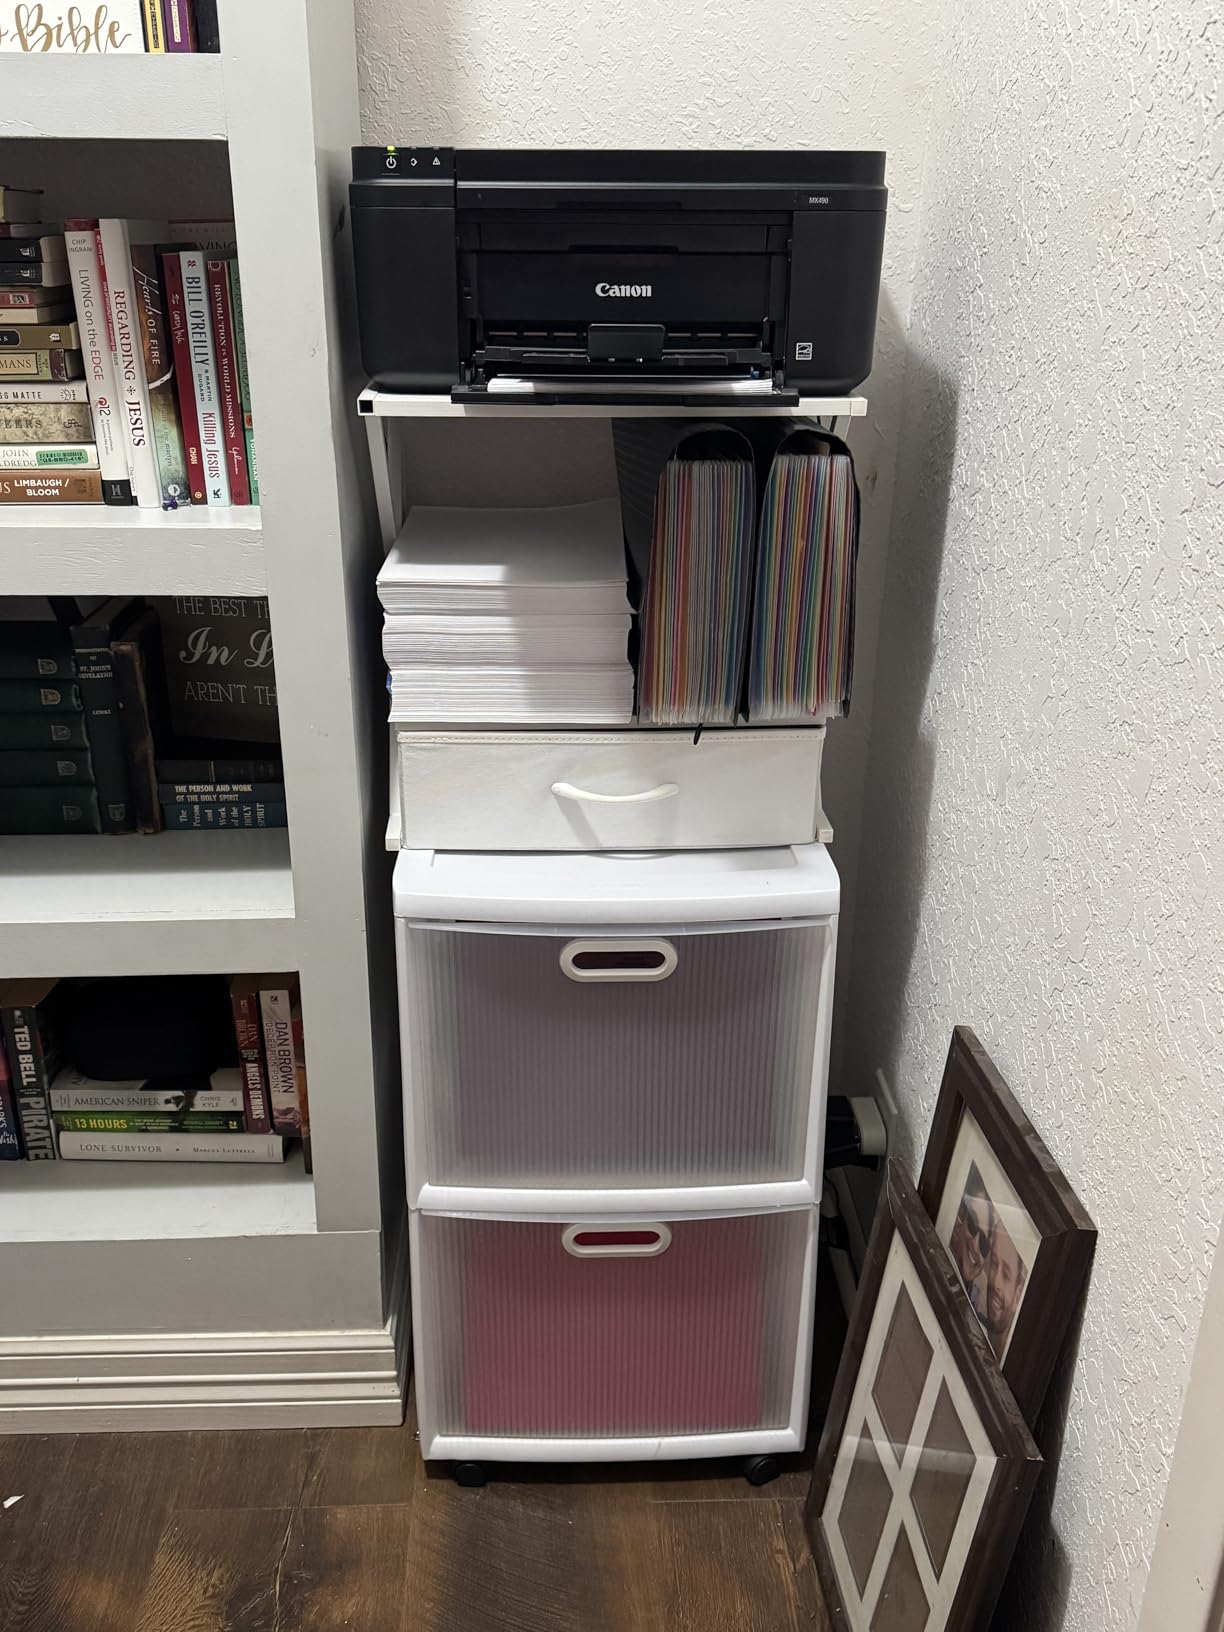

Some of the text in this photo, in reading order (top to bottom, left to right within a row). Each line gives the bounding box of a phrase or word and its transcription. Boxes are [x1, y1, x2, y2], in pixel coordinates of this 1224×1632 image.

[11, 3, 132, 53] Bible
[808, 196, 829, 204] MX490
[68, 246, 93, 254] INGRAM
[595, 282, 652, 297] Canon
[78, 269, 104, 381] LIVING on the EDGE
[147, 319, 157, 333] OF
[186, 276, 209, 366] BILL O'REILLY
[149, 339, 161, 365] FIRE
[113, 290, 145, 447] REGARDING JESUS
[220, 357, 231, 392] WORLD
[12, 391, 42, 399] MATTE
[205, 375, 213, 402] MARTIN
[225, 393, 236, 438] MISSIONS
[2, 449, 29, 458] JOHN
[189, 447, 198, 465] CHAN
[202, 412, 220, 479] Killing Jesus
[14, 479, 62, 487] LIMBAUGH
[26, 488, 59, 496] BLOOM
[175, 597, 205, 615] THE
[209, 598, 247, 618] BEST
[178, 626, 239, 666] In
[184, 681, 247, 704] AREN'T
[174, 784, 253, 793] THE PERSON AND WORK
[176, 794, 239, 802] OF THE HOLY SPIRIT
[179, 809, 188, 823] The
[218, 806, 227, 826] Work
[243, 805, 253, 826] HOLY
[256, 803, 265, 827] SPIRIT
[13, 1025, 31, 1051] TED
[274, 1021, 295, 1094] DAN BROWN
[18, 1054, 37, 1086] BELL
[245, 1063, 261, 1089] ANGELS
[271, 1070, 280, 1093] POINT
[74, 1097, 160, 1105] AMERICAN SNIPER
[249, 1090, 265, 1119] DEMONS
[19, 1096, 55, 1160] PIRATE
[75, 1119, 87, 1128] 13
[89, 1119, 128, 1129] HOURS
[80, 1144, 162, 1153] LONE SURVIVOR
